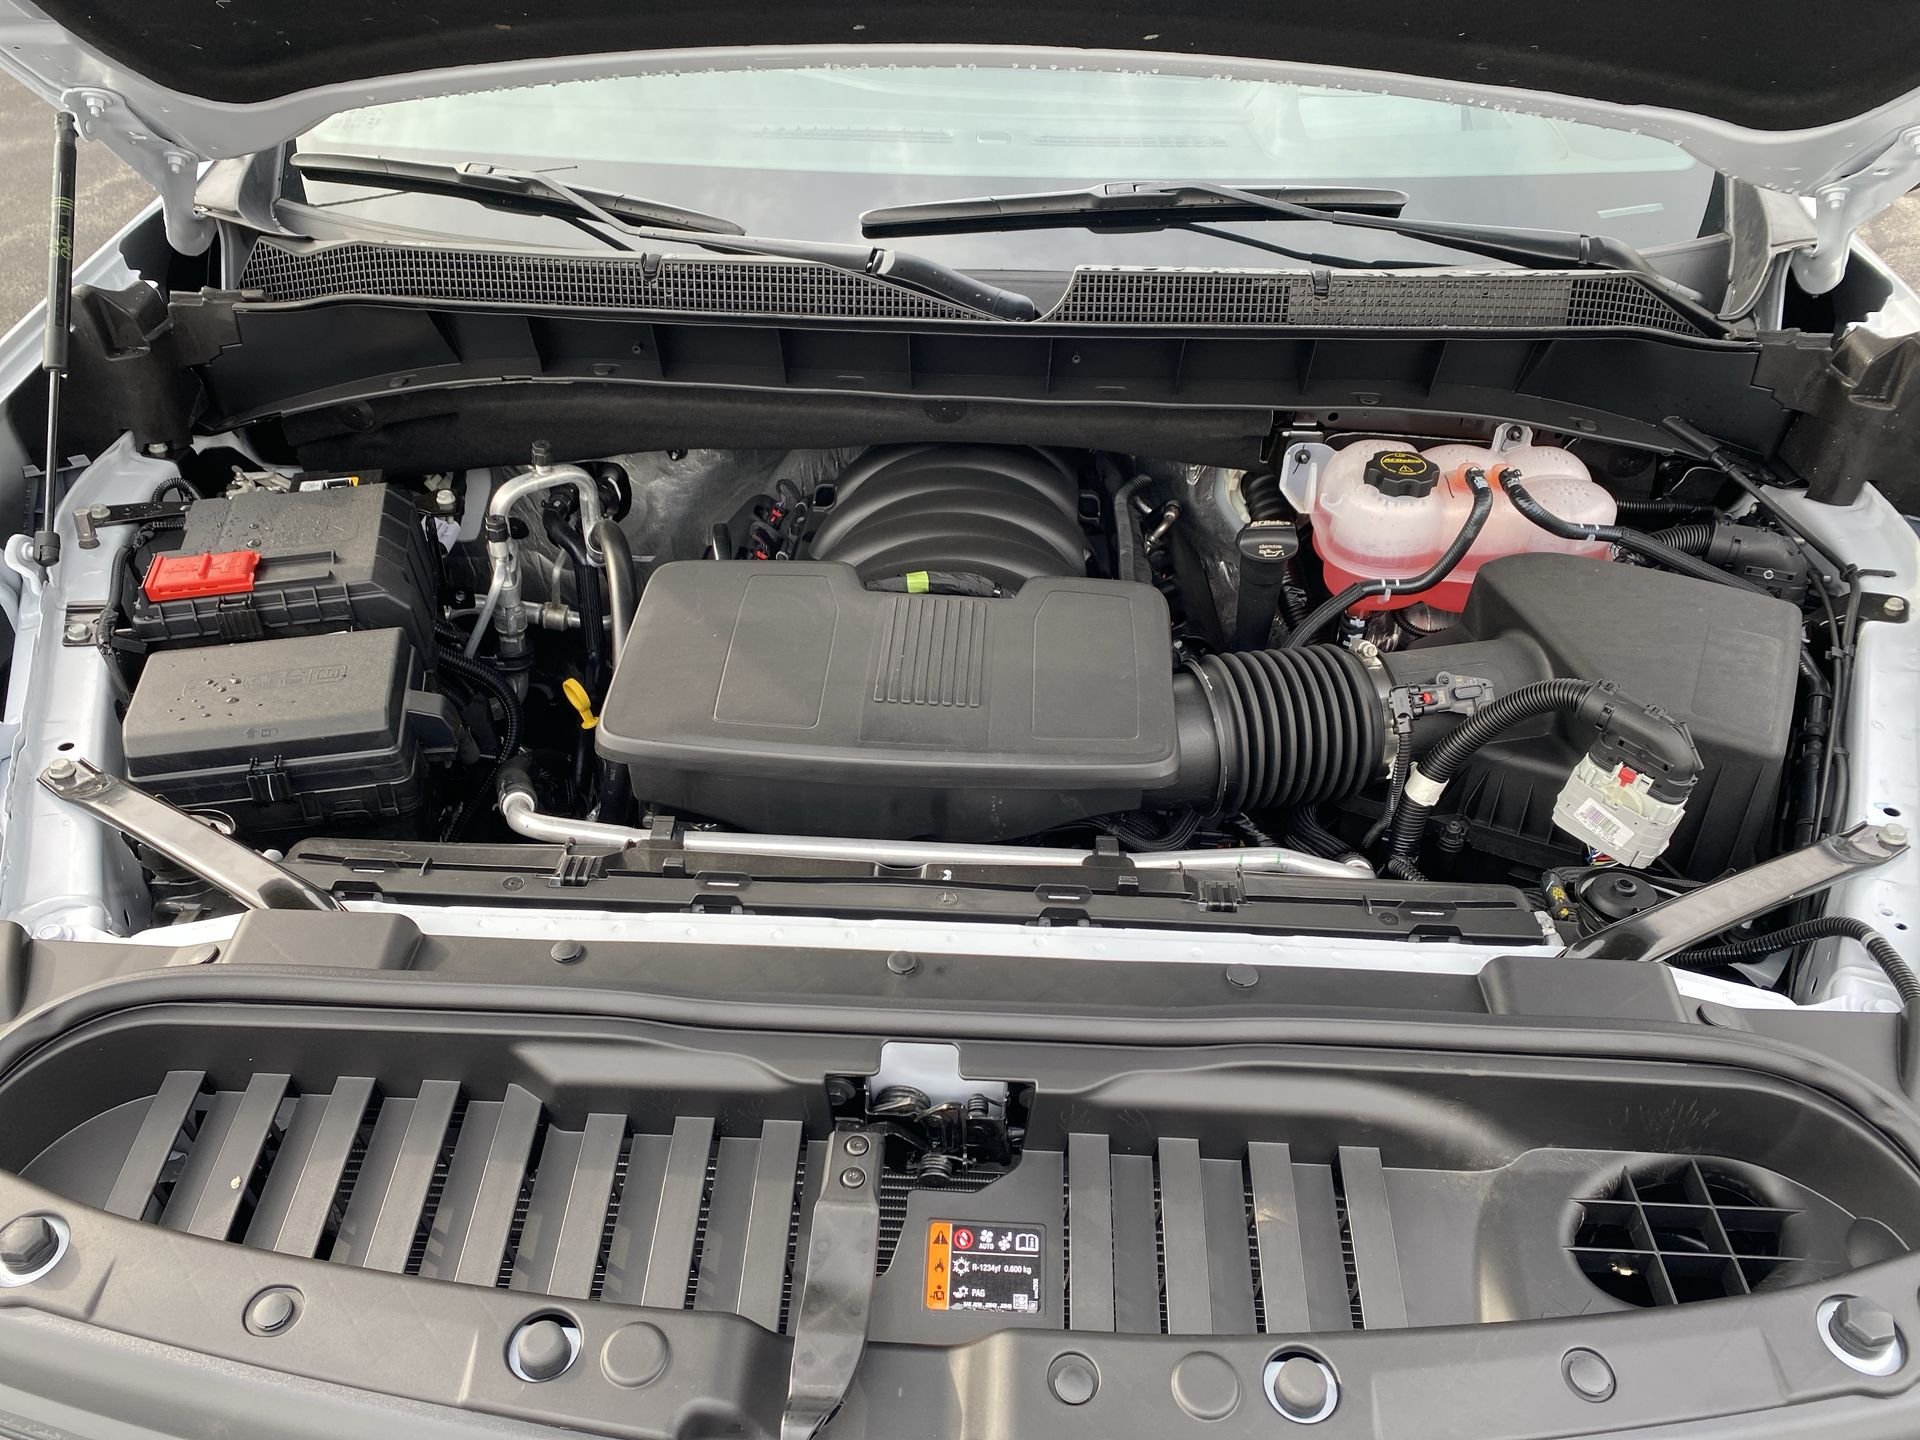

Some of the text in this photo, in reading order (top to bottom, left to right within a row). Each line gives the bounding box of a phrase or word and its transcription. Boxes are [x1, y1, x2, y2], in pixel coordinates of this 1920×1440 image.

[979, 1242, 994, 1250] AUTO
[972, 1263, 1001, 1274] R-1234yf
[1023, 1265, 1032, 1275] kg
[972, 1289, 985, 1297] PAG
